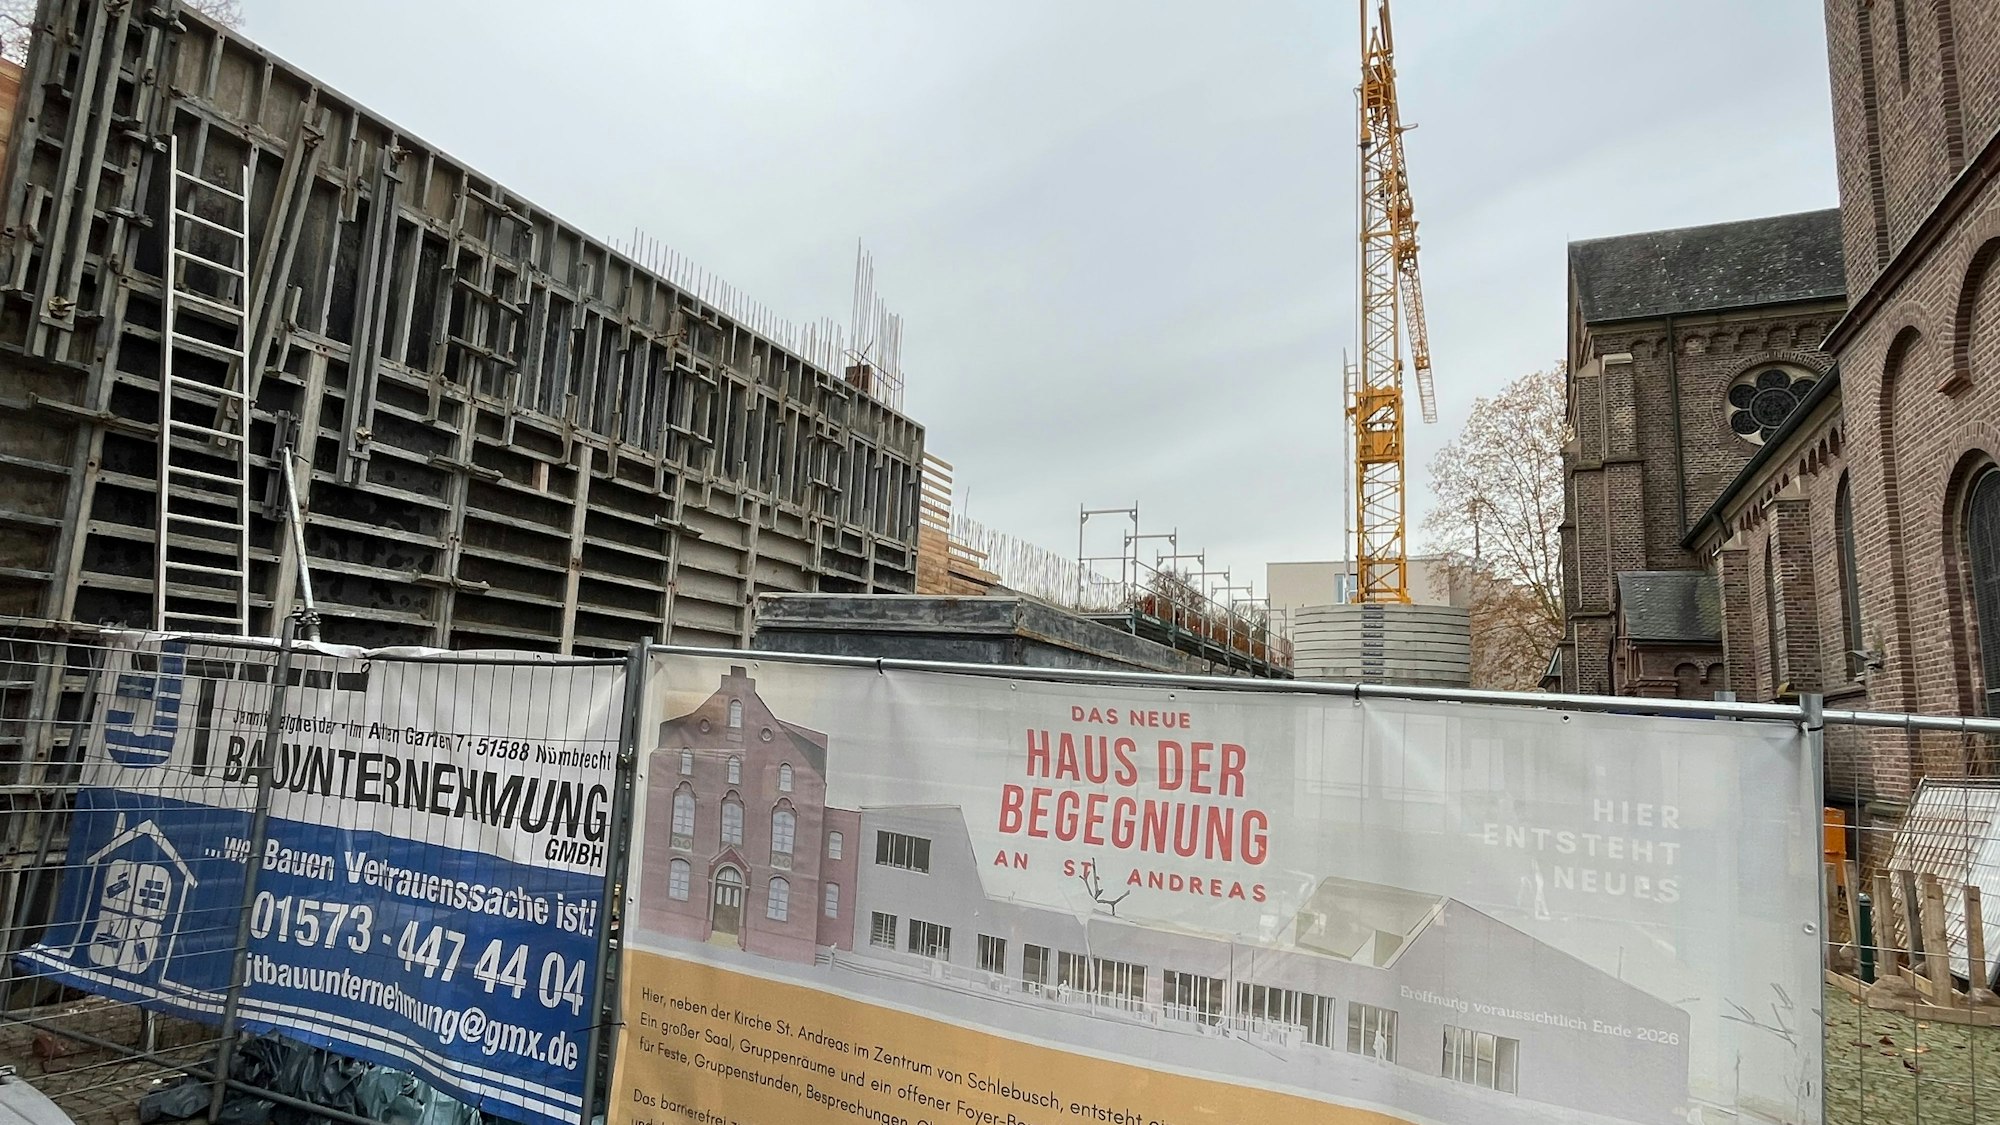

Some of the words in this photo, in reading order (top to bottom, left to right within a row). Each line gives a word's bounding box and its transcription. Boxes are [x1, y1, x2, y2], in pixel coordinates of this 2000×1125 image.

[1071, 705, 1117, 725] DAS
[1130, 709, 1191, 729] NEUE
[405, 727, 451, 751] Garten
[456, 734, 465, 753] 7
[476, 738, 530, 761] 51588
[536, 744, 611, 770] Nümbrecht
[1026, 728, 1138, 787] HAUS
[1157, 739, 1247, 797] DER
[223, 735, 608, 842] BAUUNTERNEHMUNG
[1593, 798, 1680, 830] HIER
[545, 838, 603, 867] GMBH
[998, 783, 1269, 865] BEGEGNUNG
[1483, 823, 1680, 865] ENTSTEHT
[262, 838, 335, 881] Bauen
[556, 893, 597, 937] ist!
[993, 850, 1028, 870] AN
[1126, 868, 1266, 902] ANDREAS
[1554, 864, 1680, 903] NEUES
[250, 891, 373, 954] 01573
[397, 920, 466, 982] 447
[473, 939, 529, 999] 44
[538, 951, 586, 1016] 04
[243, 952, 578, 1070] jtbauunternehmung@gmx.de
[1400, 985, 1468, 1013] Eröffnung
[1473, 1003, 1587, 1031] voraussichtlich
[1592, 1020, 1632, 1038] Ende
[1637, 1027, 1679, 1046] 2026
[639, 1036, 655, 1054] für
[657, 1042, 690, 1066] Feste,
[694, 1053, 802, 1098] Gruppenstunden,
[640, 1012, 657, 1029] Ein
[661, 1021, 700, 1040] großer
[705, 1029, 735, 1051] Saal,
[739, 1038, 836, 1077] Gruppenräume
[841, 1071, 865, 1087] und
[871, 1079, 892, 1095] ein
[897, 1084, 950, 1112] offener
[642, 987, 666, 1008] Hier,
[670, 997, 707, 1015] neben
[711, 1003, 731, 1020] der
[734, 1009, 772, 1031] Kirche
[776, 1019, 793, 1038] St.
[797, 1025, 850, 1053] Andreas
[854, 1042, 869, 1059] im
[873, 1046, 932, 1076] Zentrum
[937, 1067, 962, 1085] von
[967, 1072, 1063, 1113] Schlebusch,
[1070, 1102, 1142, 1125] entsteht
[633, 1088, 656, 1107] Das
